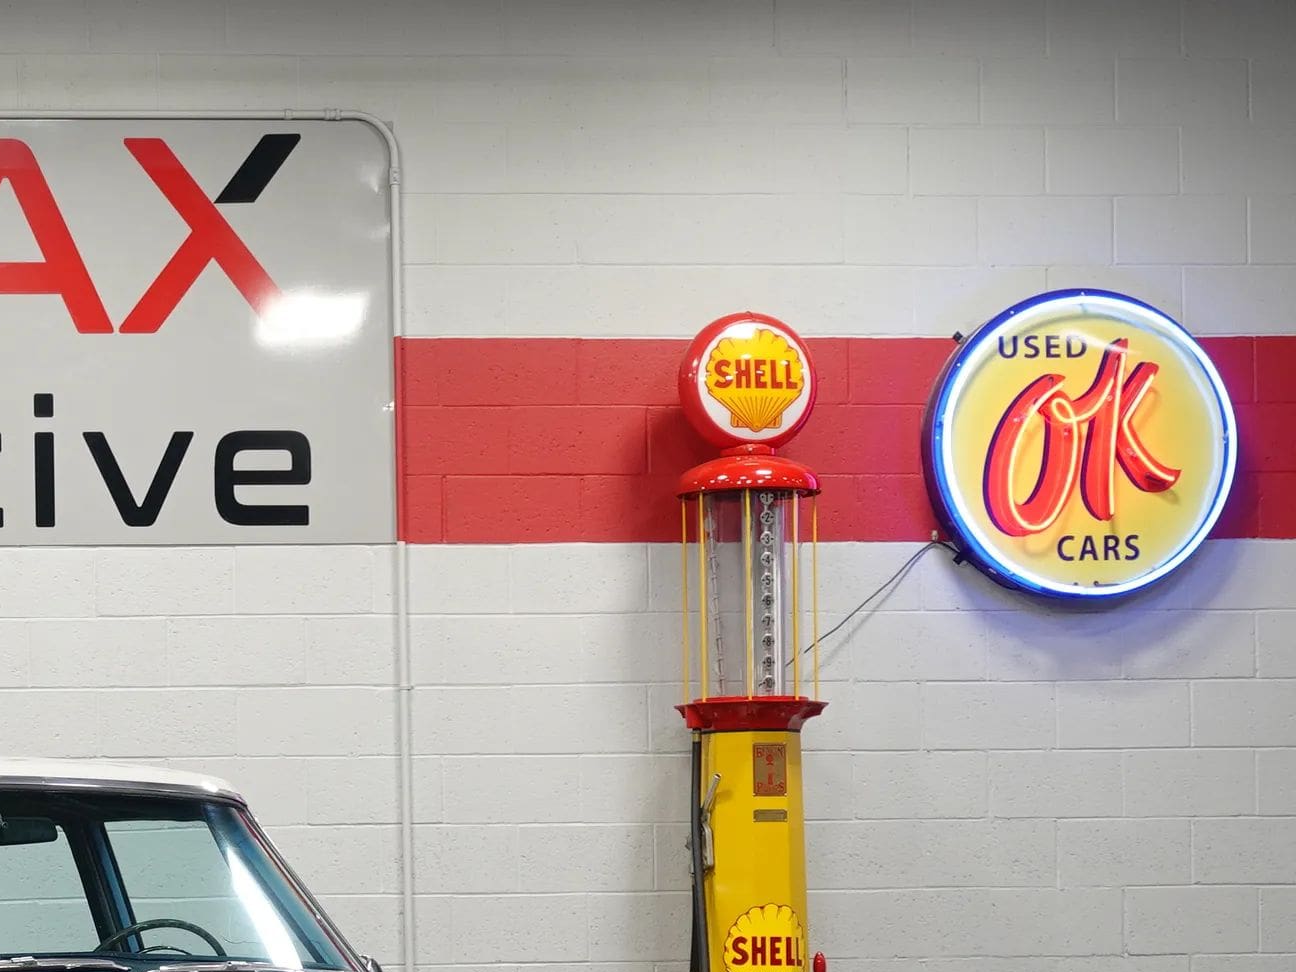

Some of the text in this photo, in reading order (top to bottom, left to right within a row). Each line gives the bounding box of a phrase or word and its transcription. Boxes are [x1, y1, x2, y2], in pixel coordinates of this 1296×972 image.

[998, 335, 1087, 358] USED
[714, 359, 798, 389] SHELL
[982, 338, 1181, 536] OK
[765, 512, 770, 523] 2
[765, 533, 770, 544] 3
[1057, 535, 1140, 561] CARS
[766, 554, 771, 565] 4
[766, 574, 771, 586] 5
[765, 595, 771, 606] 6
[766, 616, 771, 626] 7
[765, 635, 772, 647] 8
[766, 656, 772, 668] 9
[732, 936, 802, 966] SHELL
